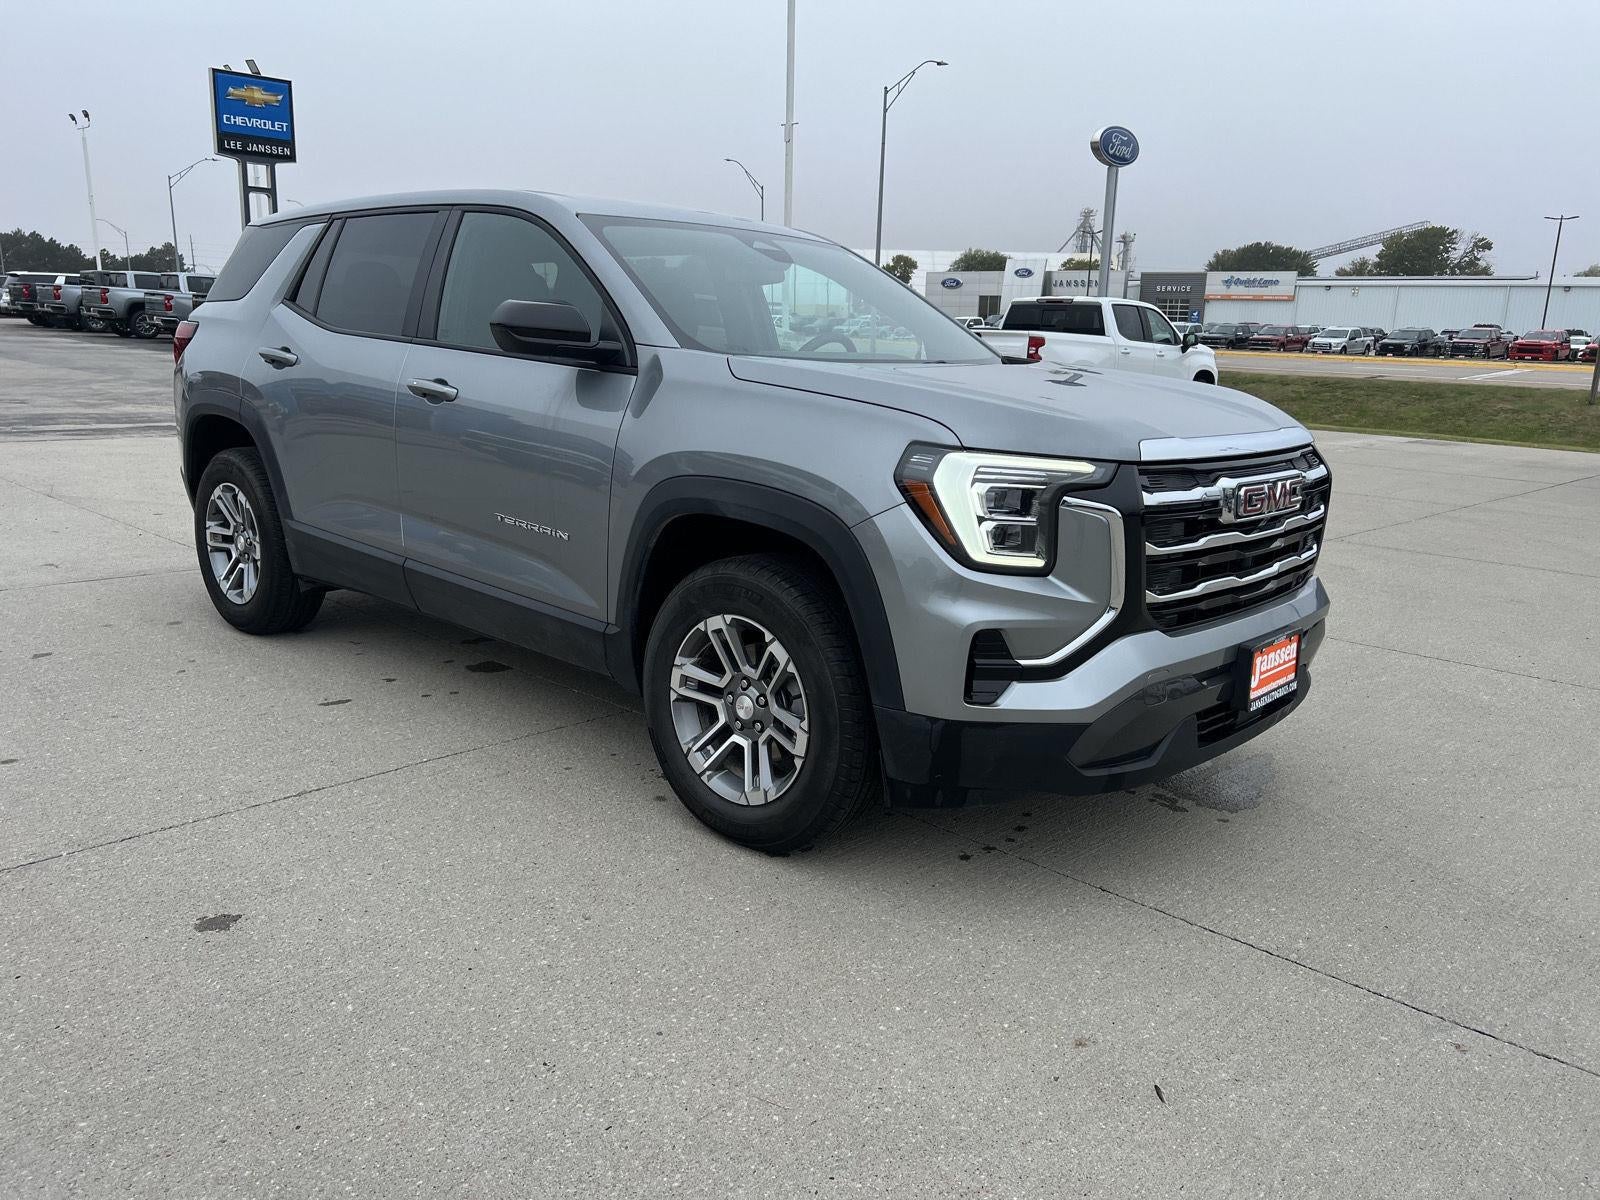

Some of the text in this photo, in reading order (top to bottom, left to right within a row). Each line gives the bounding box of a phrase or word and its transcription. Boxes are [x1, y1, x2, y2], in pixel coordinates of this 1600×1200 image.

[223, 114, 288, 132] CHEVROLET
[224, 139, 291, 156] LEE JANSSEN
[1108, 132, 1134, 159] Ford
[1238, 477, 1303, 517] GMC
[494, 512, 569, 541] TERRAIN
[1250, 641, 1298, 689] Janssen
